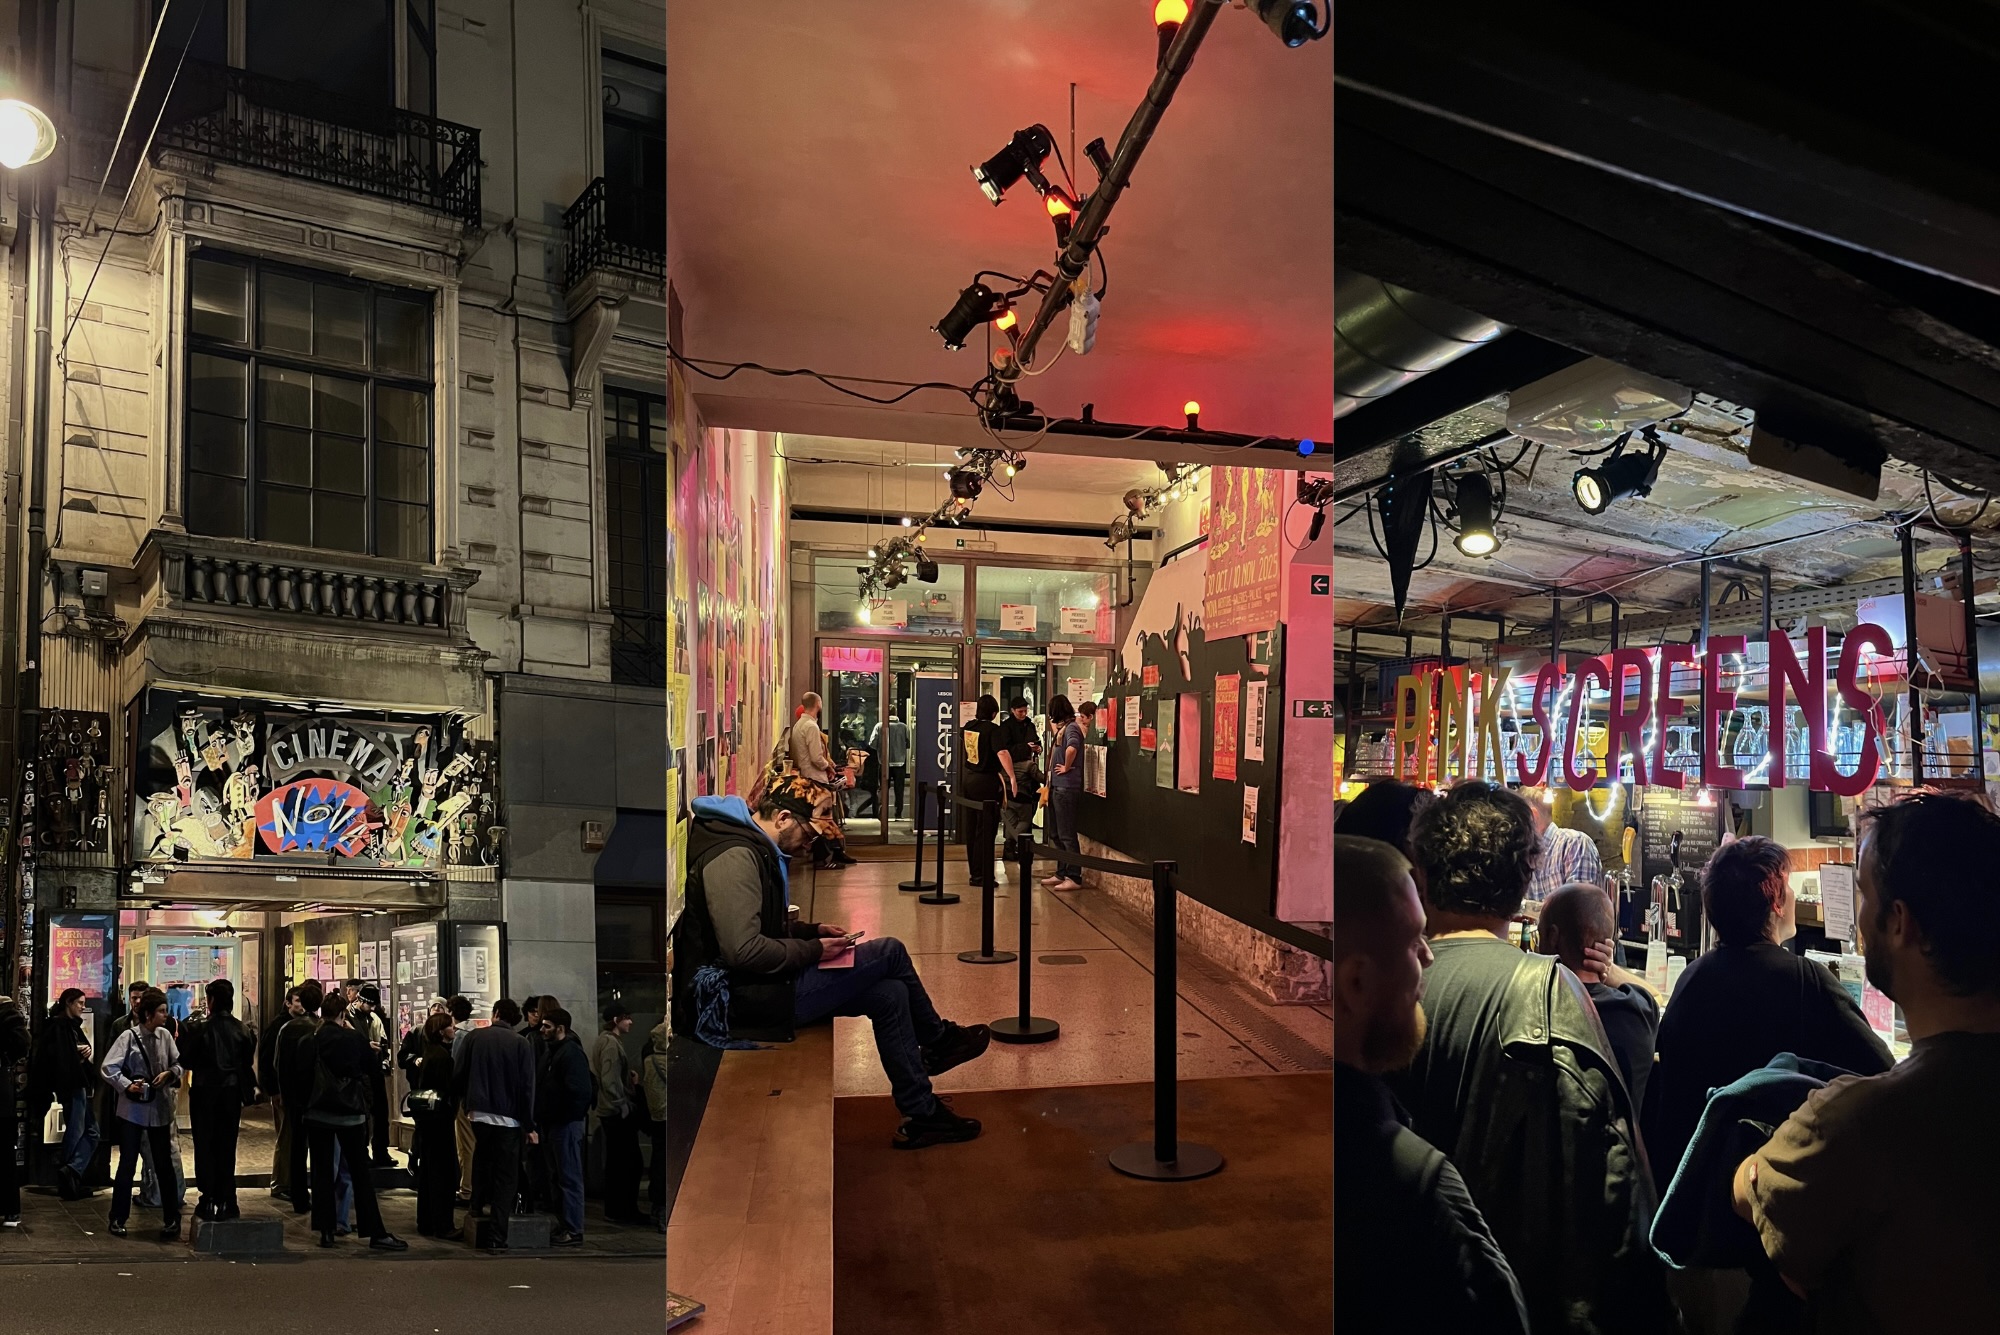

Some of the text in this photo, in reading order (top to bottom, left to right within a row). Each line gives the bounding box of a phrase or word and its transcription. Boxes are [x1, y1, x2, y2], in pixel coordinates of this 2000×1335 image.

[1207, 574, 1215, 597] 30
[1215, 568, 1229, 594] OCT
[1233, 565, 1241, 589] 10
[1258, 554, 1278, 582] 2025
[1396, 622, 1894, 797] PINK SCREENS
[271, 728, 393, 787] CINEMA
[272, 785, 370, 848] NOVA
[56, 930, 83, 939] PINK
[56, 939, 102, 948] SCREENS
